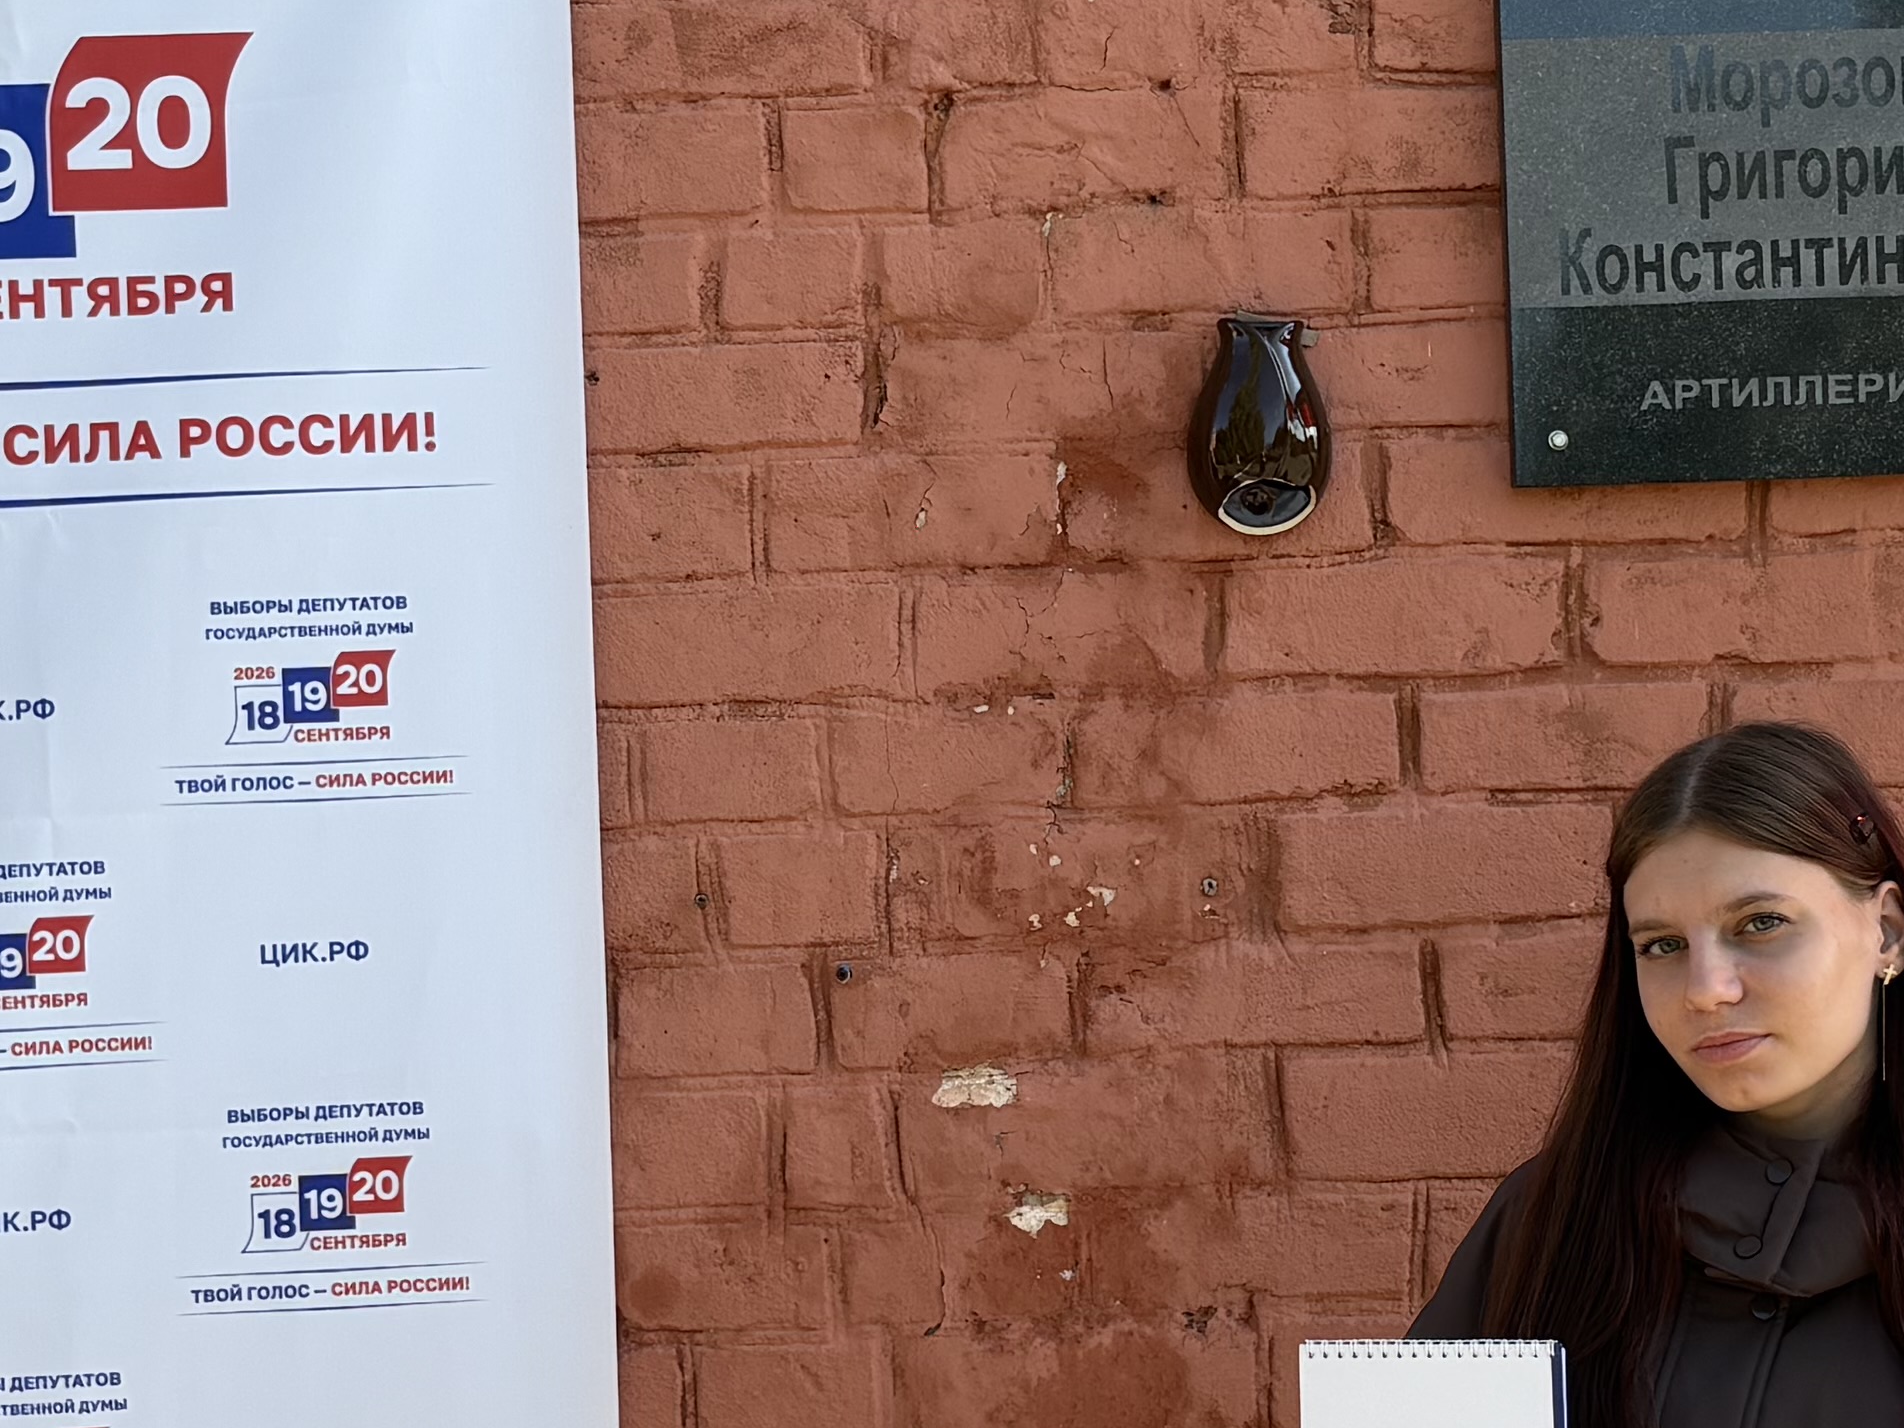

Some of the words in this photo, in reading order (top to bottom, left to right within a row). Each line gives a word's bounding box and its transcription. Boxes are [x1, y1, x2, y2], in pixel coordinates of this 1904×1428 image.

[63, 74, 214, 173] 20
[3, 420, 162, 466] СИЛА
[178, 411, 437, 459] РОССИИ!
[210, 599, 293, 616] ВЫБОРЫ
[297, 595, 408, 615] ДЕПУТАТОВ
[205, 620, 362, 641] ГОСУДАРСТВЕННОЙ
[365, 621, 414, 637] ДУМЫ
[233, 666, 276, 681] 2026
[241, 700, 281, 731] 18
[287, 680, 328, 712] 19
[335, 663, 383, 695] 20
[293, 725, 391, 743] СЕНТЯБРЯ
[174, 774, 227, 794] ТВОЙ
[231, 775, 295, 792] ГОЛОС
[315, 773, 367, 789] СИЛА
[371, 769, 454, 787] РОССИИ!
[260, 939, 369, 968] ЦИК.РФ
[9, 1371, 122, 1393] ДЕПУТАТОВ
[78, 1398, 128, 1415] ДУМЫ
